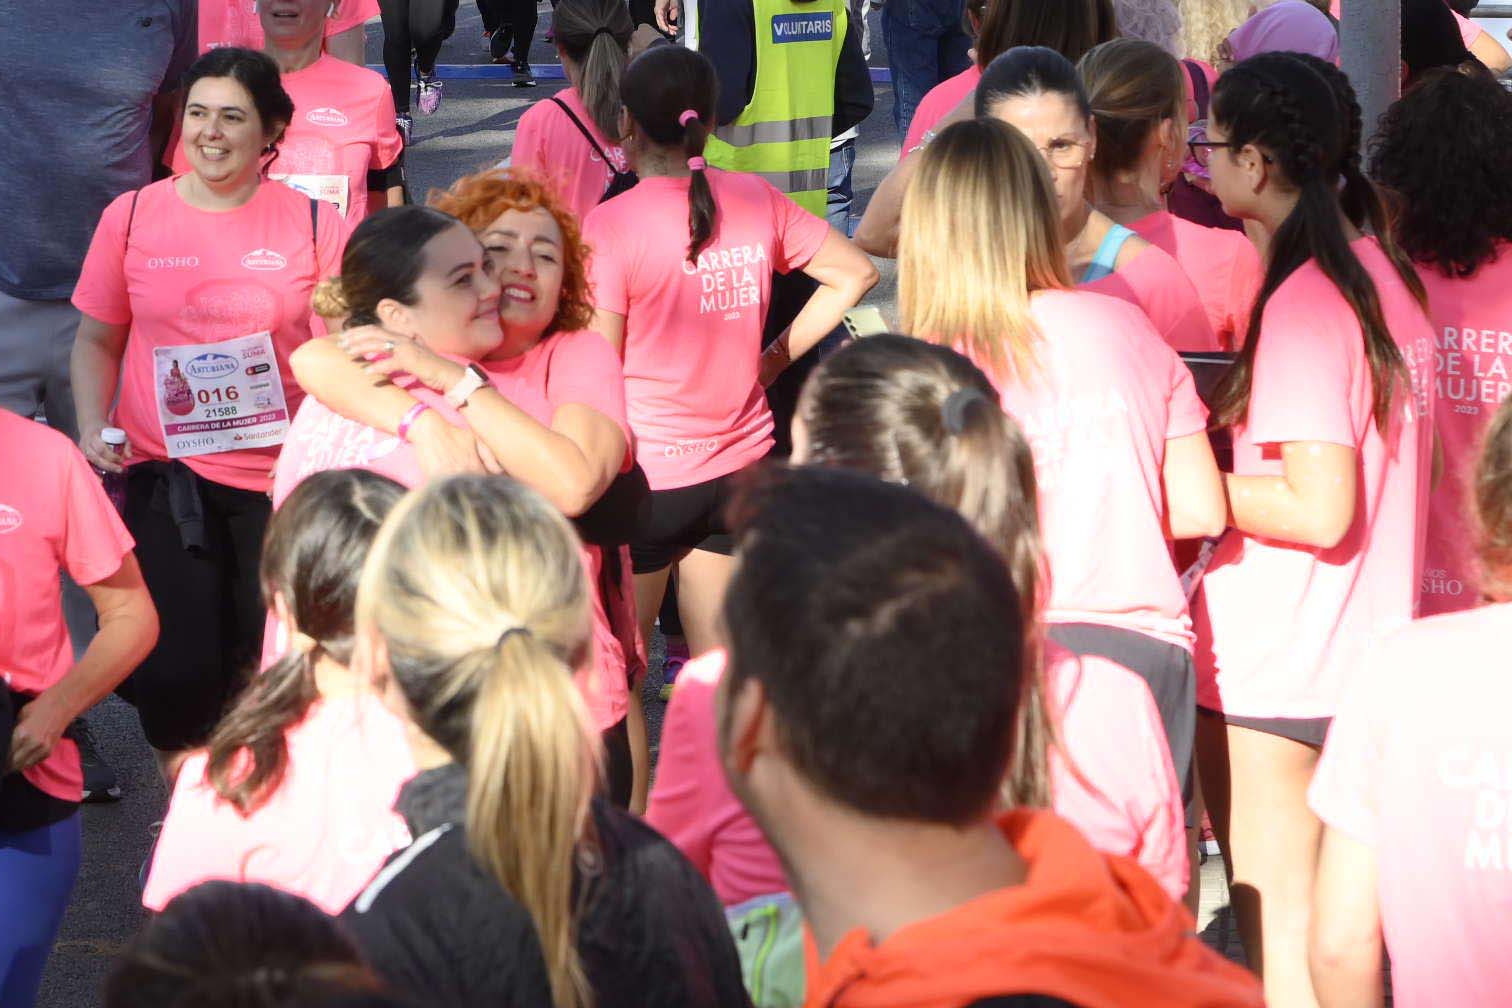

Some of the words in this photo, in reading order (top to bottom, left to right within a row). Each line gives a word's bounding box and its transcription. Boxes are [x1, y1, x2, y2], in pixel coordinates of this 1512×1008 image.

[773, 19, 832, 36] VOLUNTARIS
[147, 255, 200, 270] OYSHO
[682, 243, 768, 276] CARRERA
[702, 272, 726, 292] DE
[732, 270, 756, 288] LA
[700, 285, 761, 315] MUJER
[189, 361, 236, 375] ASTURIANA
[1473, 355, 1507, 377] LA
[197, 386, 239, 405] 016
[205, 405, 238, 418] 21588
[177, 424, 210, 433] CARRERA
[211, 422, 221, 430] DE
[221, 421, 231, 429] LA
[232, 417, 257, 427] MUJER
[259, 413, 276, 422] 2023
[176, 436, 215, 450] OYSHO
[243, 428, 282, 442] Santander
[664, 439, 719, 459] OYSHO
